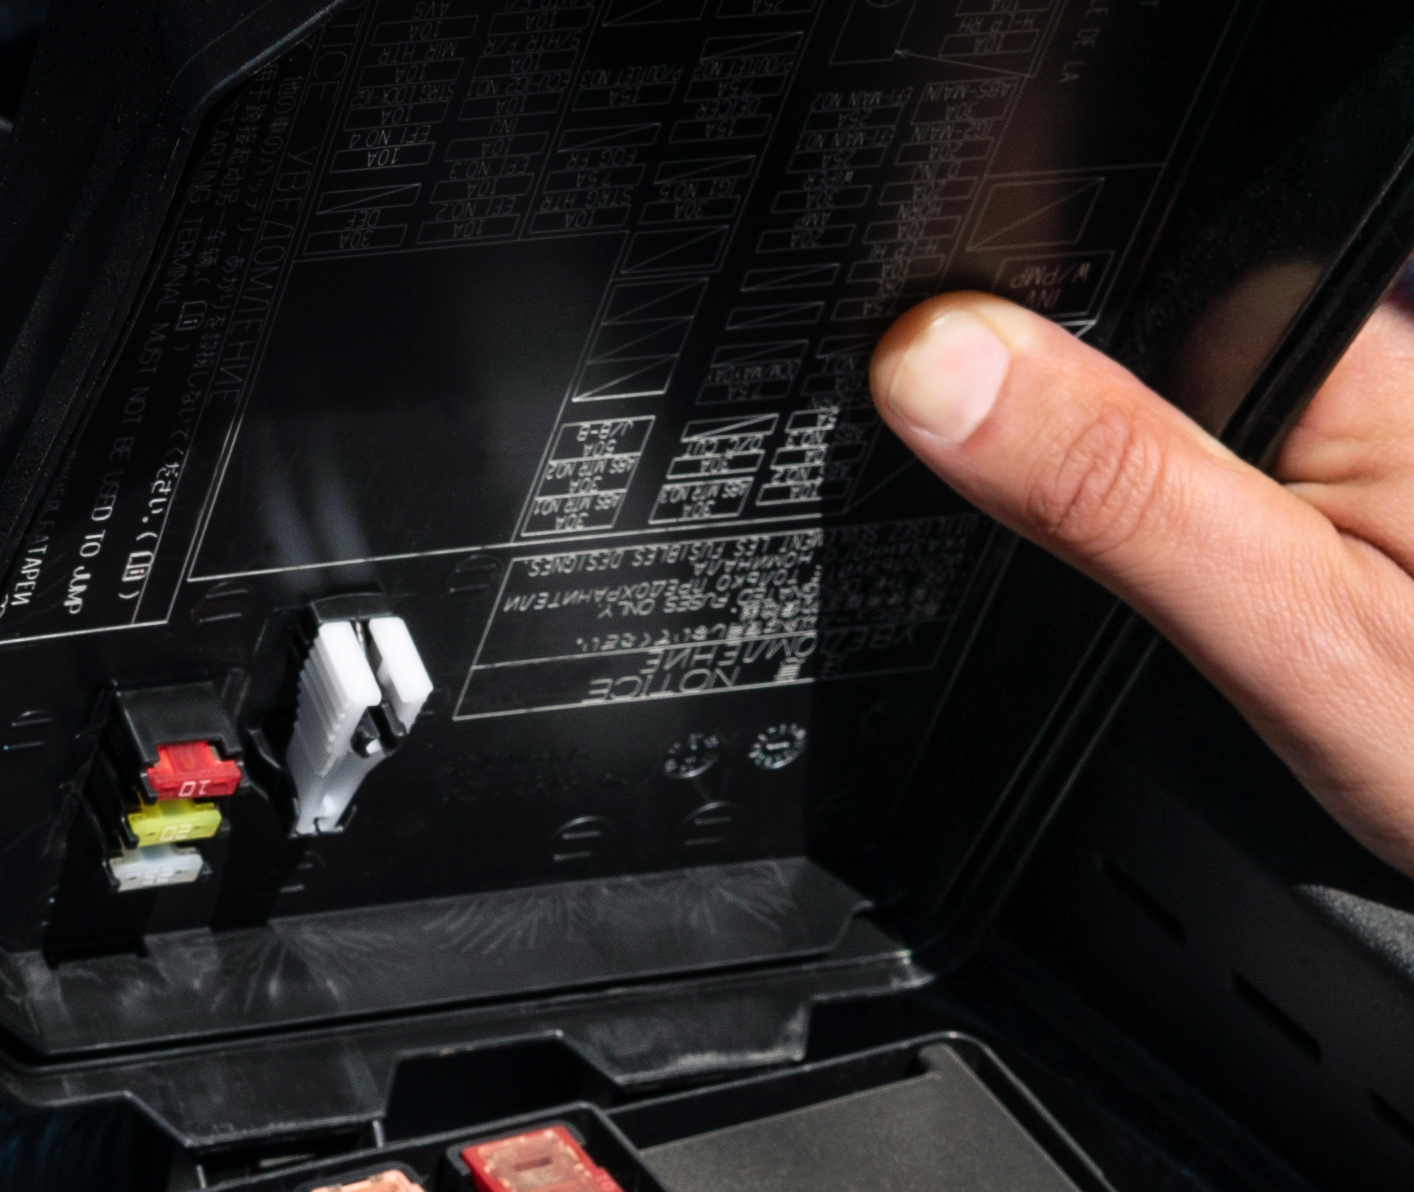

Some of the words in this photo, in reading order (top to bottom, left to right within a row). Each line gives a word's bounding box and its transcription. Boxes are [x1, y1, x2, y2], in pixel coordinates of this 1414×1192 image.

[410, 0, 453, 20] AVS
[520, 9, 560, 32] 10A
[404, 18, 444, 41] 10A
[523, 28, 585, 53] S/HTR
[375, 42, 417, 65] HTR
[422, 39, 459, 60] MIR
[480, 33, 520, 56] F/R
[968, 33, 1007, 55] 10A
[390, 61, 430, 84] 10A
[505, 52, 545, 75] 10A
[612, 60, 686, 87] P/OUTLET
[725, 51, 798, 78] P/OUTLET
[1055, 58, 1087, 83] LA
[417, 79, 458, 102] STRG
[502, 68, 573, 96] ECU-IG2
[921, 76, 1014, 105] ABS-MAIN
[347, 82, 417, 109] LOCK-IG2
[490, 94, 530, 116] 10A
[603, 85, 642, 106] 15A
[843, 85, 914, 111] EFI-MAIN
[376, 104, 415, 126] 10A
[692, 94, 763, 121] DEICER
[399, 123, 432, 144] EFI
[486, 116, 519, 136] INJ
[700, 117, 739, 139] 15A
[346, 127, 393, 149] NO.4
[476, 135, 515, 157] 10A
[827, 125, 897, 151] EFI-MAIN
[362, 146, 401, 167] 10A
[497, 154, 531, 176] EFI
[562, 150, 591, 172] FR
[596, 145, 639, 169] FOG
[446, 158, 493, 180] NO.3
[462, 177, 501, 199] 10A
[581, 185, 635, 209] STRG
[432, 198, 479, 221] NO.2
[483, 194, 517, 216] EFI
[537, 191, 578, 213] HTR
[669, 199, 710, 222] 30A
[342, 208, 381, 230] DEF
[448, 217, 486, 239] 10A
[559, 208, 597, 230] 10A
[792, 210, 832, 230] AMP
[335, 228, 373, 251] 30A
[154, 214, 204, 312] TERMINAL
[205, 145, 319, 406] УВЕДОМЛЕНИЕ
[134, 322, 170, 377] MUST
[118, 386, 151, 427] NOT
[107, 436, 136, 462] BE
[578, 438, 618, 459] 50A
[605, 454, 637, 474] ABS
[88, 470, 124, 522] USED
[563, 474, 603, 495] 30A
[591, 491, 623, 510] ABS
[550, 511, 590, 532] 30A
[77, 529, 107, 558] TO
[629, 539, 726, 567] FUSIBLES
[731, 535, 772, 557] LES
[59, 564, 94, 615] JUMP
[712, 565, 804, 591] ТОЛЬКО
[500, 575, 709, 614] ПРЕДОХРАНИТЕЛИ
[660, 590, 731, 614] FUSES
[591, 597, 658, 620] ONLY.
[580, 664, 741, 703] NOTICE
[177, 778, 211, 797] 10
